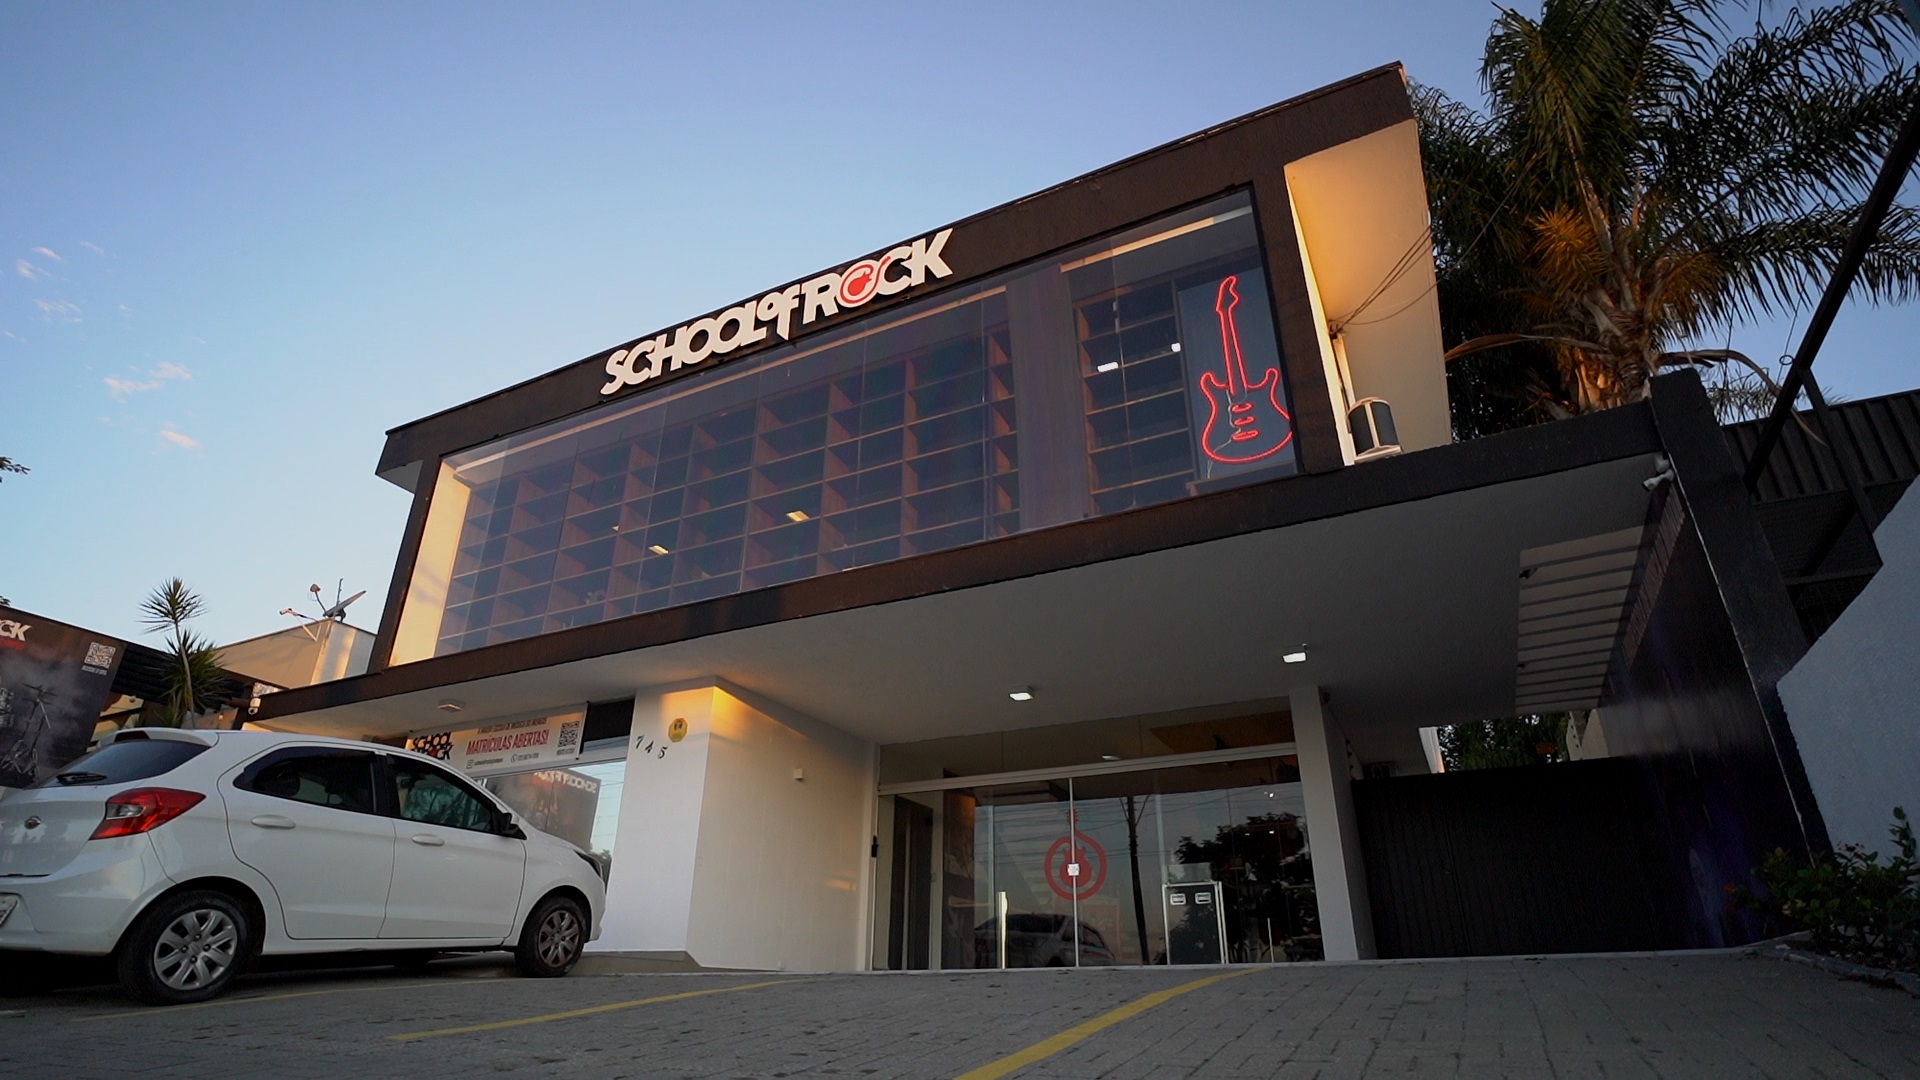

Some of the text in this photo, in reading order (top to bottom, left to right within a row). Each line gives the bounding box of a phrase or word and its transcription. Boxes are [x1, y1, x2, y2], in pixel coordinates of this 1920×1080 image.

[600, 300, 767, 395] SCHOOL
[801, 228, 953, 325] ROCK
[512, 729, 550, 749] ABERTAS!
